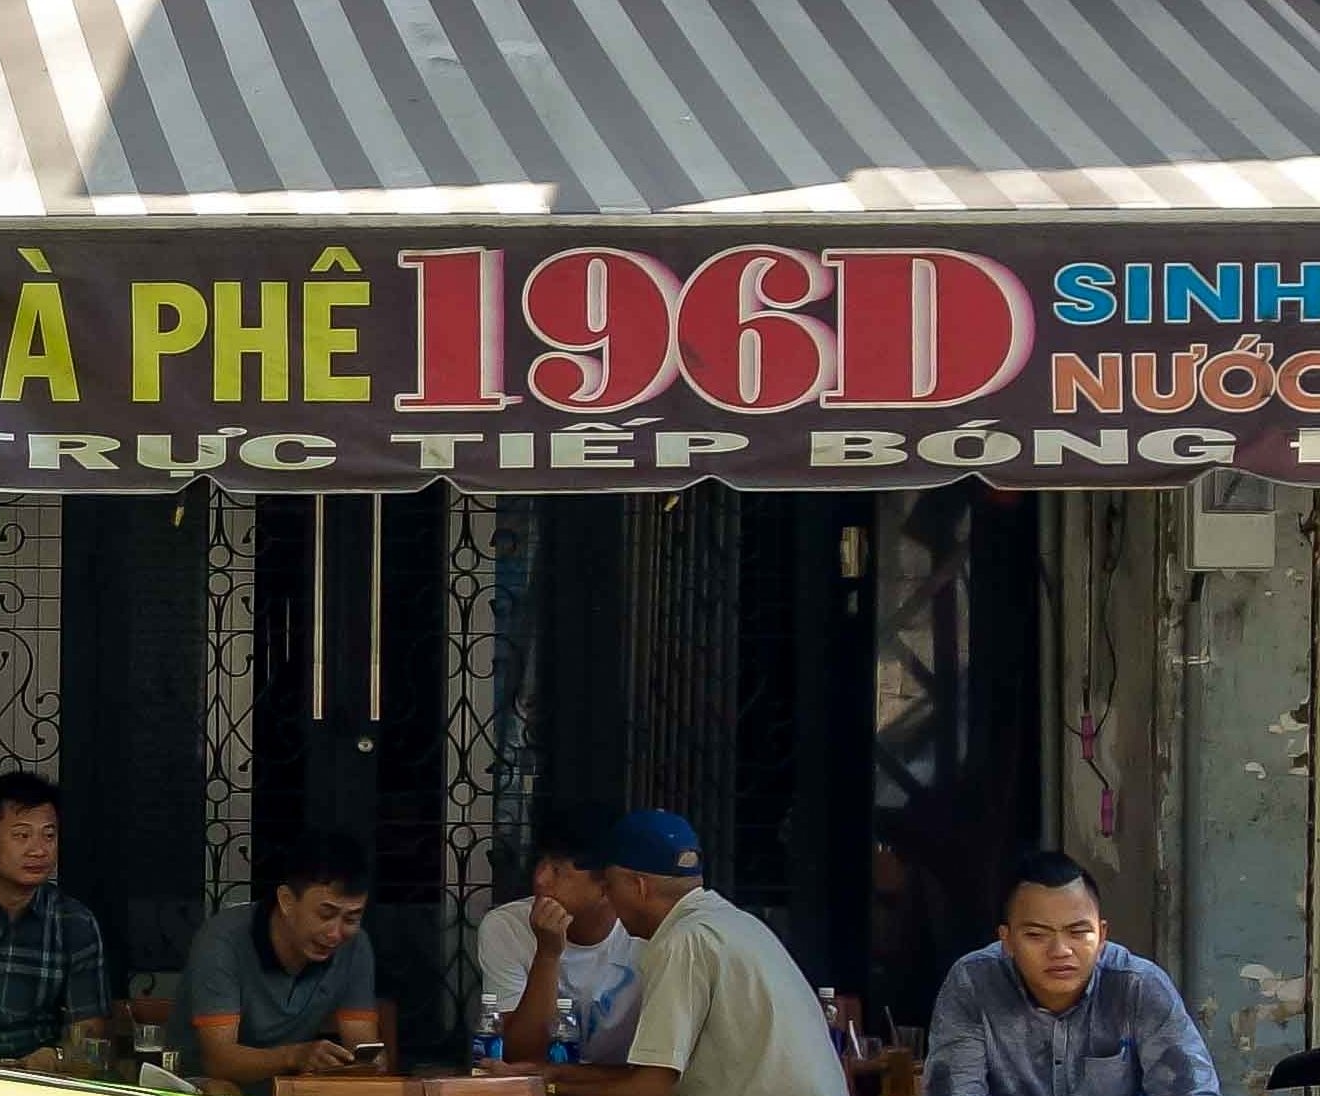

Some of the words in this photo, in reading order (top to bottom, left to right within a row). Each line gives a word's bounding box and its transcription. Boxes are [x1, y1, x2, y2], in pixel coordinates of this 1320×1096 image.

[1053, 261, 1320, 325] SINH
[131, 246, 371, 402] PHÊ
[394, 244, 1035, 415] 196D
[391, 418, 749, 469] TIẾP
[809, 419, 1241, 467] BÓNG
